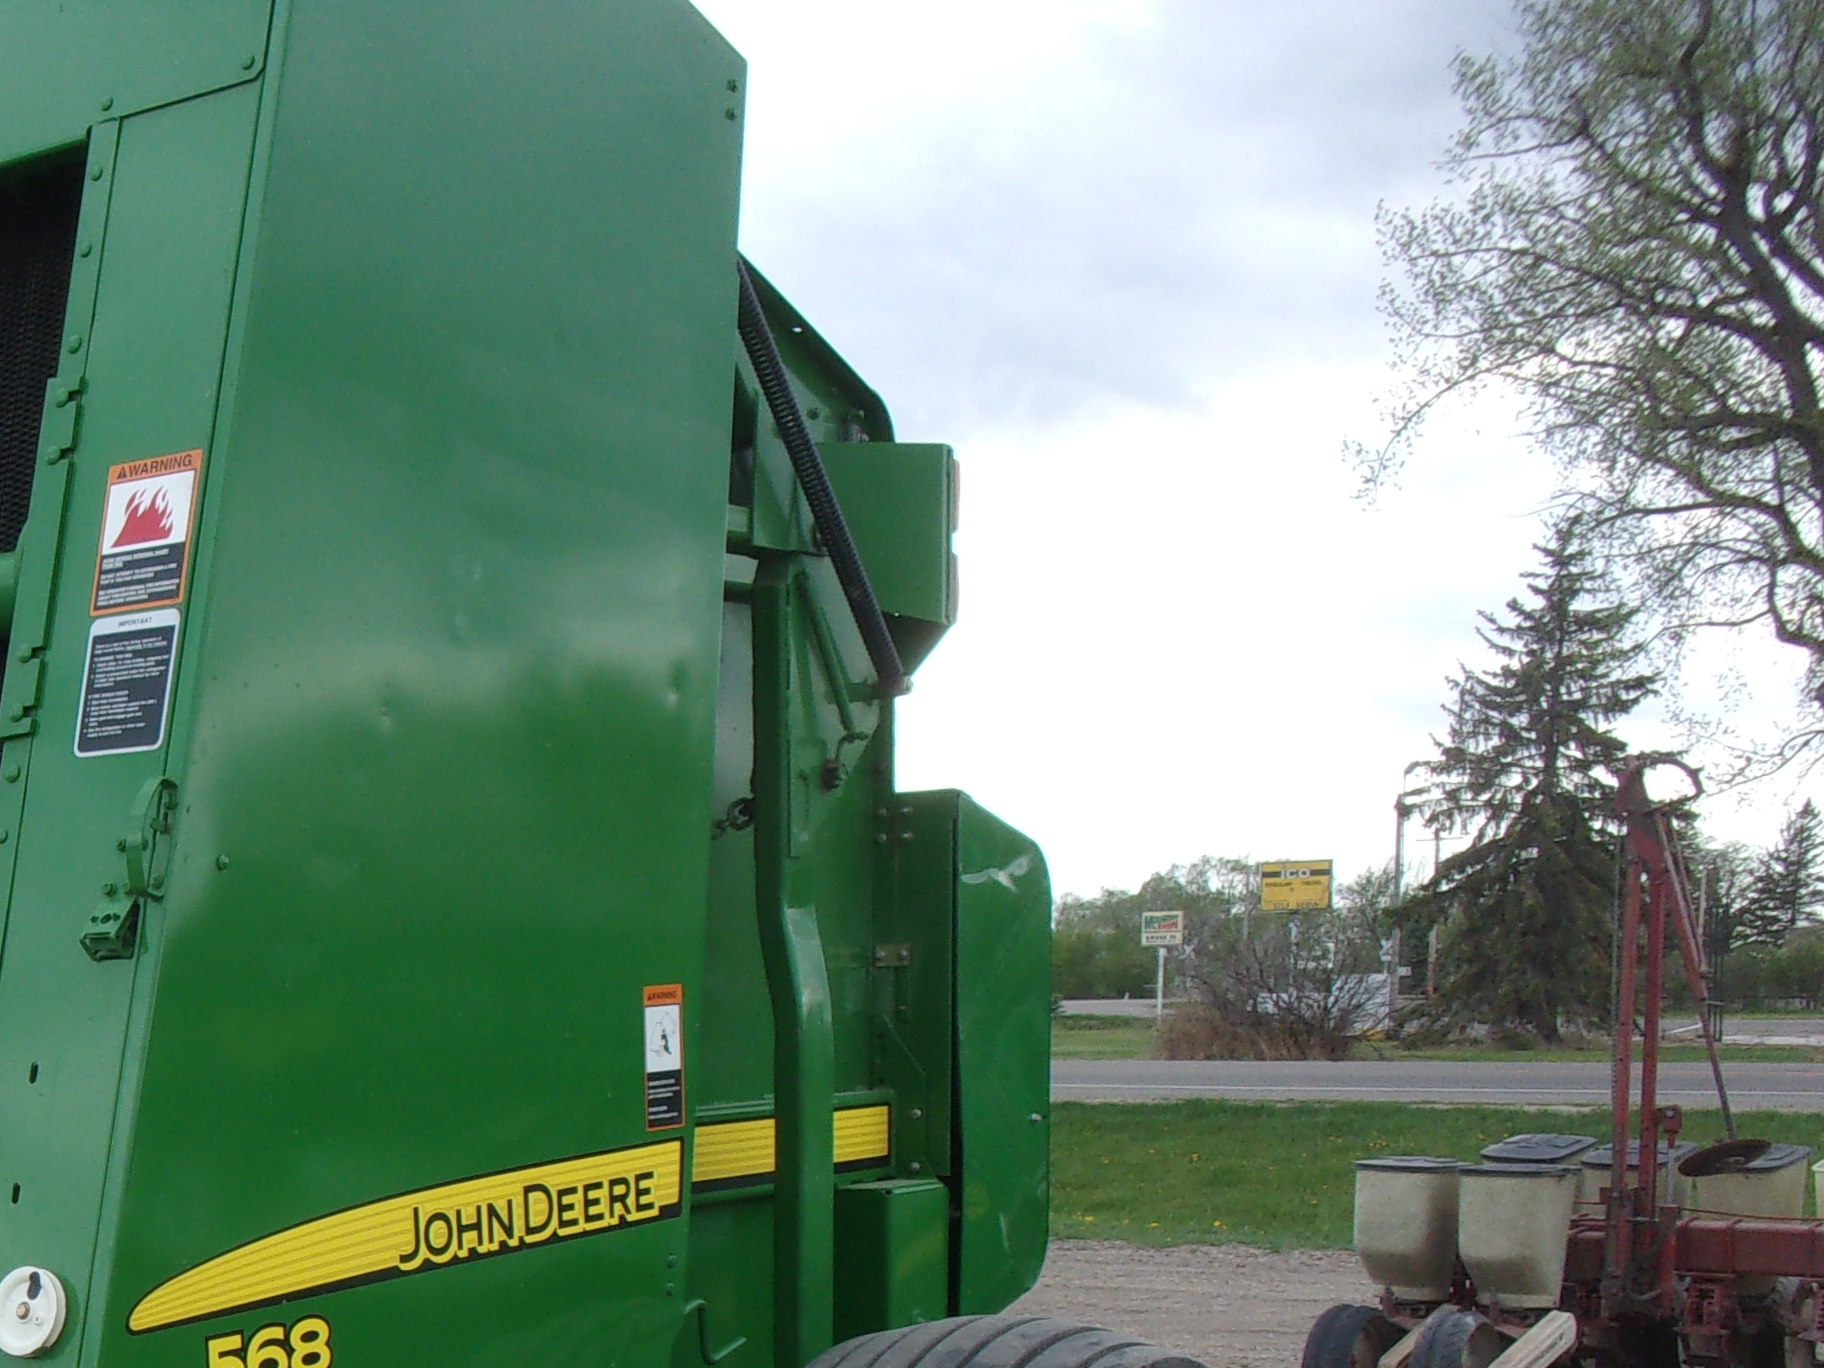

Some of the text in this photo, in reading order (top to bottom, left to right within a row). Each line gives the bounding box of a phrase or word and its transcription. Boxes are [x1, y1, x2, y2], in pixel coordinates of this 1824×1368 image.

[128, 454, 192, 477] WARNING
[118, 617, 153, 627] IMPORTANT
[398, 1170, 656, 1264] JOHN DEERE
